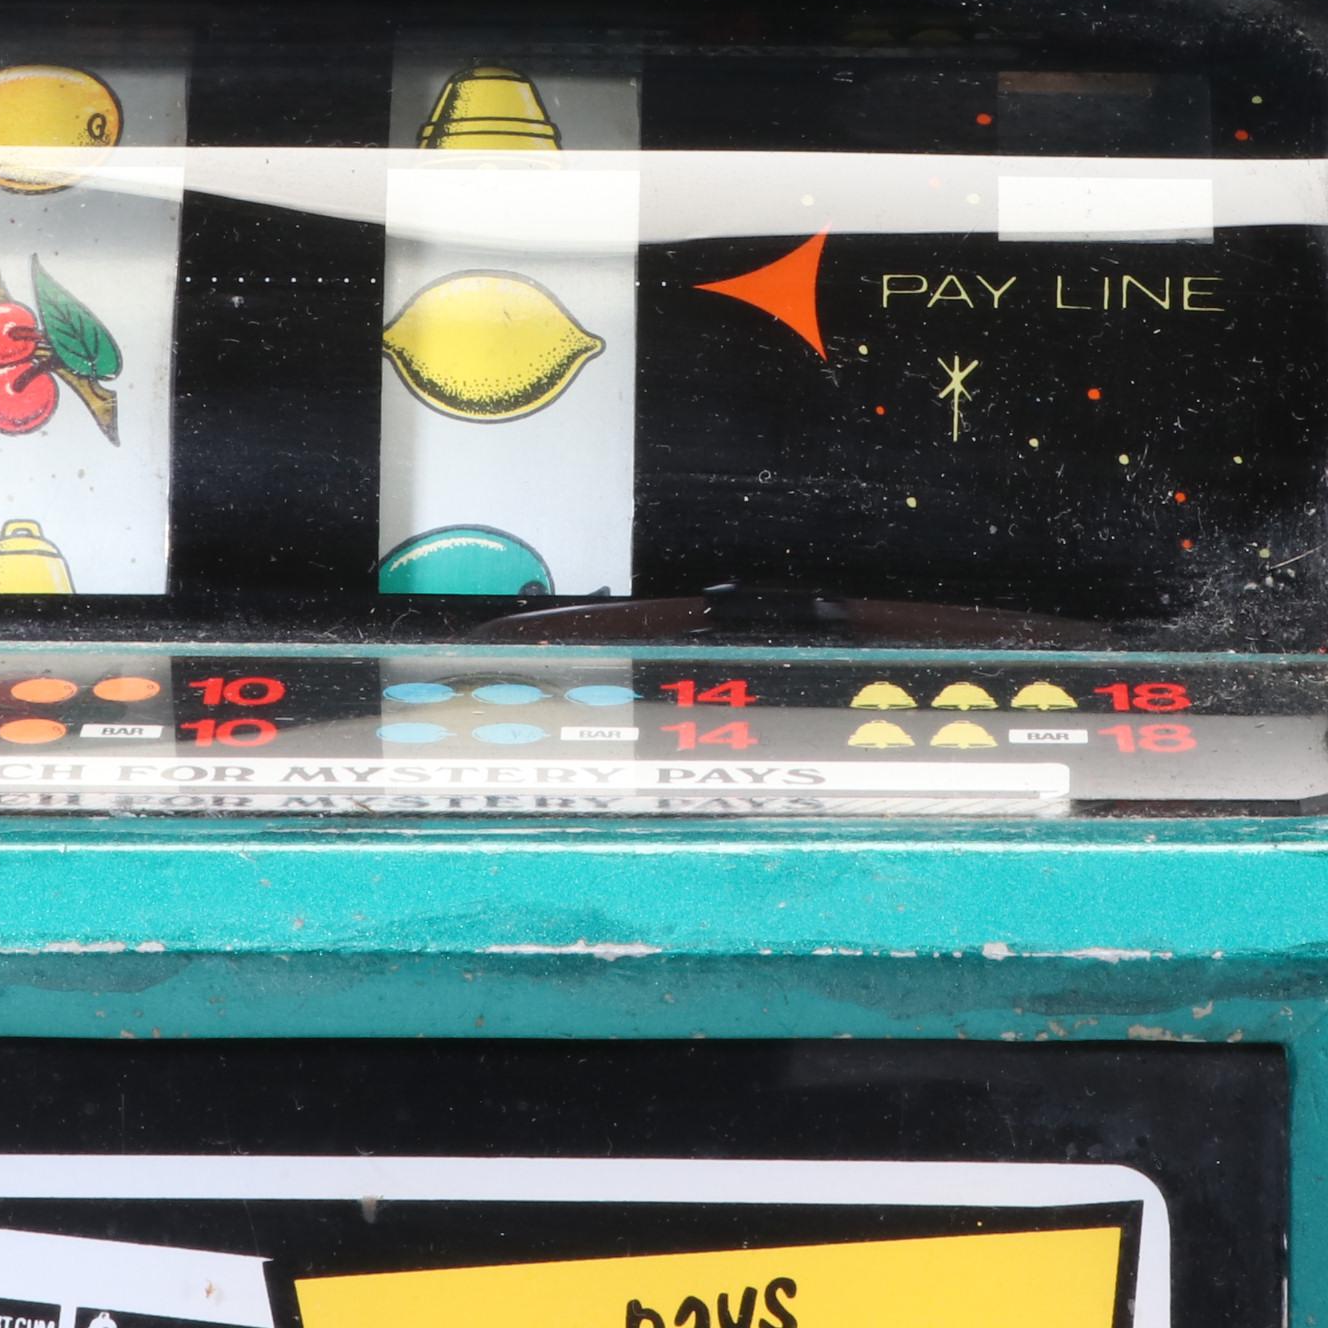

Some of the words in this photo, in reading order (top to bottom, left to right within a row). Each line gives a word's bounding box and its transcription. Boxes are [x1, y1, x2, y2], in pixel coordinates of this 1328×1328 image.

[881, 274, 1017, 310] PAY
[1056, 274, 1225, 313] LINE
[188, 676, 286, 706] 10
[659, 679, 758, 708] 14
[1093, 681, 1192, 712] 18
[101, 726, 144, 737] BAR
[180, 718, 278, 748] 10
[578, 728, 622, 739] BAR
[660, 721, 759, 750] 14
[1026, 731, 1070, 742] BAR
[1096, 723, 1198, 753] 18
[116, 764, 256, 782] FOR
[279, 766, 626, 784] MYSTERY
[655, 767, 827, 785] PAYS
